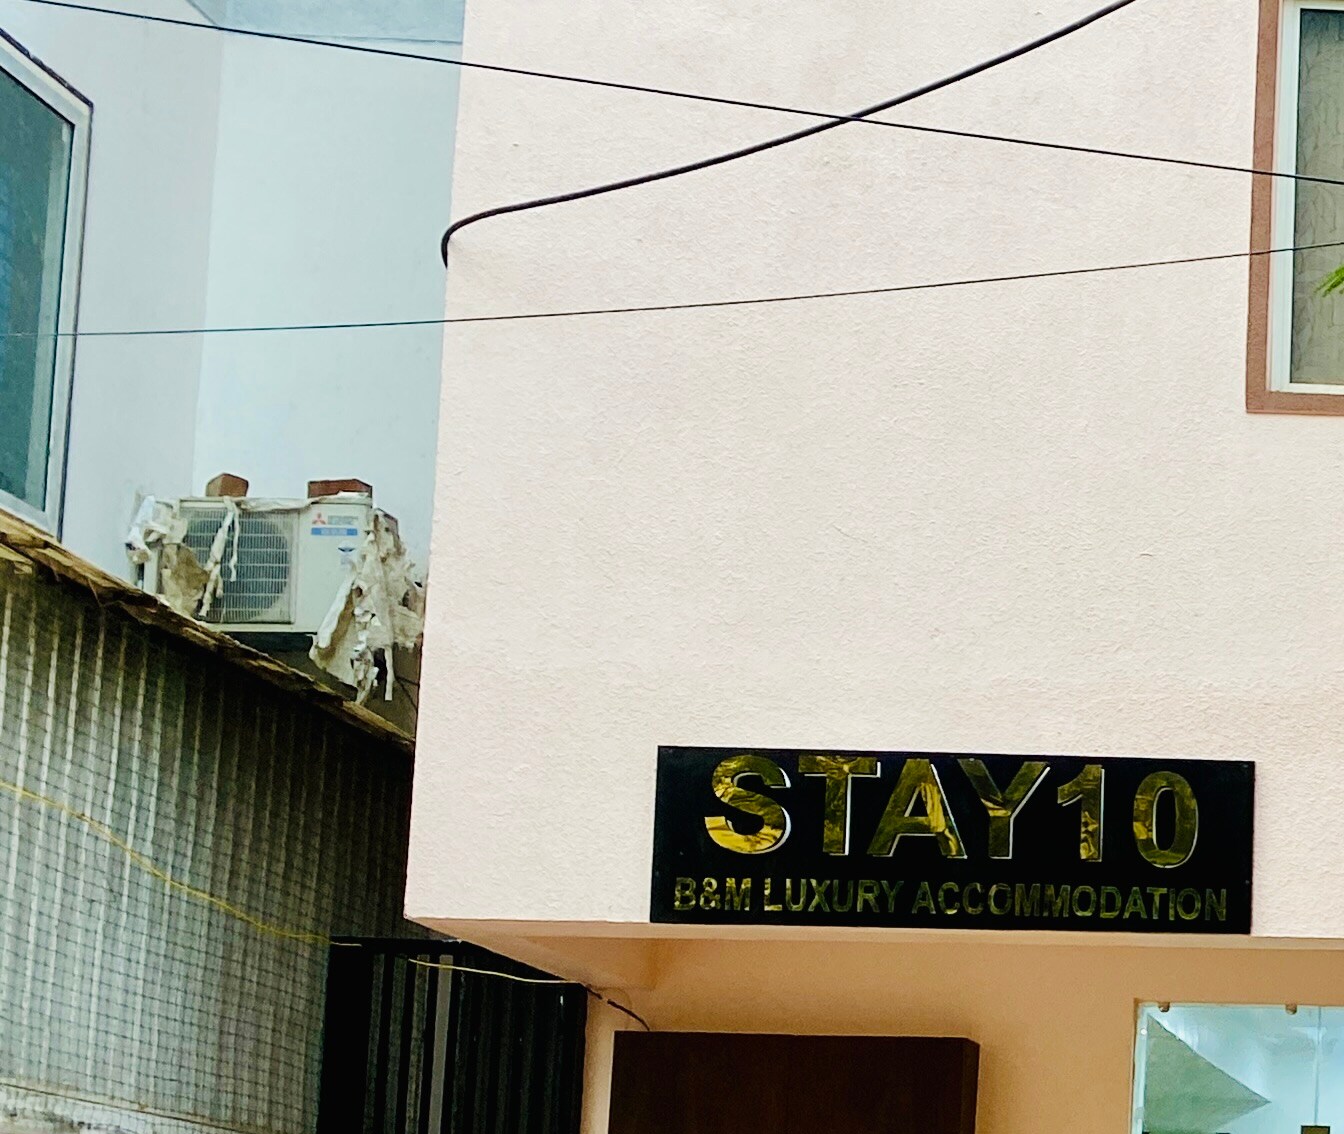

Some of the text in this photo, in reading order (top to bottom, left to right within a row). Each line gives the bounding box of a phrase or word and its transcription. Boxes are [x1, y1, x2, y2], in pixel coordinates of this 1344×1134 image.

[704, 755, 1200, 868] STAY10
[674, 877, 1227, 921] B&M LUXURY ACCOMMODATION
